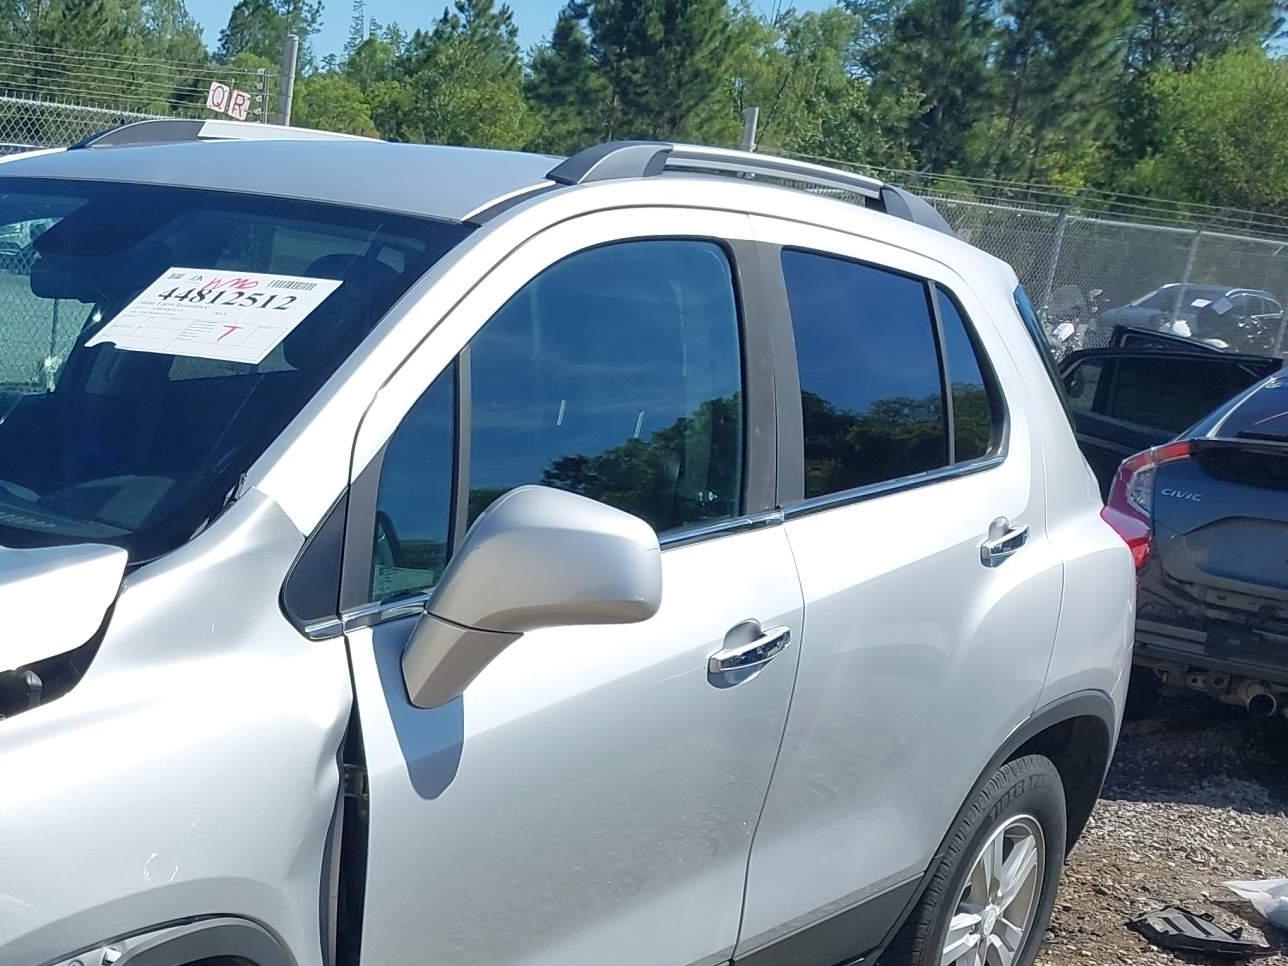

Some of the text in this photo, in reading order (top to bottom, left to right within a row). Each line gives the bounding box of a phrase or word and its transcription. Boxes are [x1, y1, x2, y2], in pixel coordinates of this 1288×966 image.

[213, 86, 245, 117] Q R
[157, 286, 298, 311] 44812512
[1161, 488, 1201, 502] CIVIC
